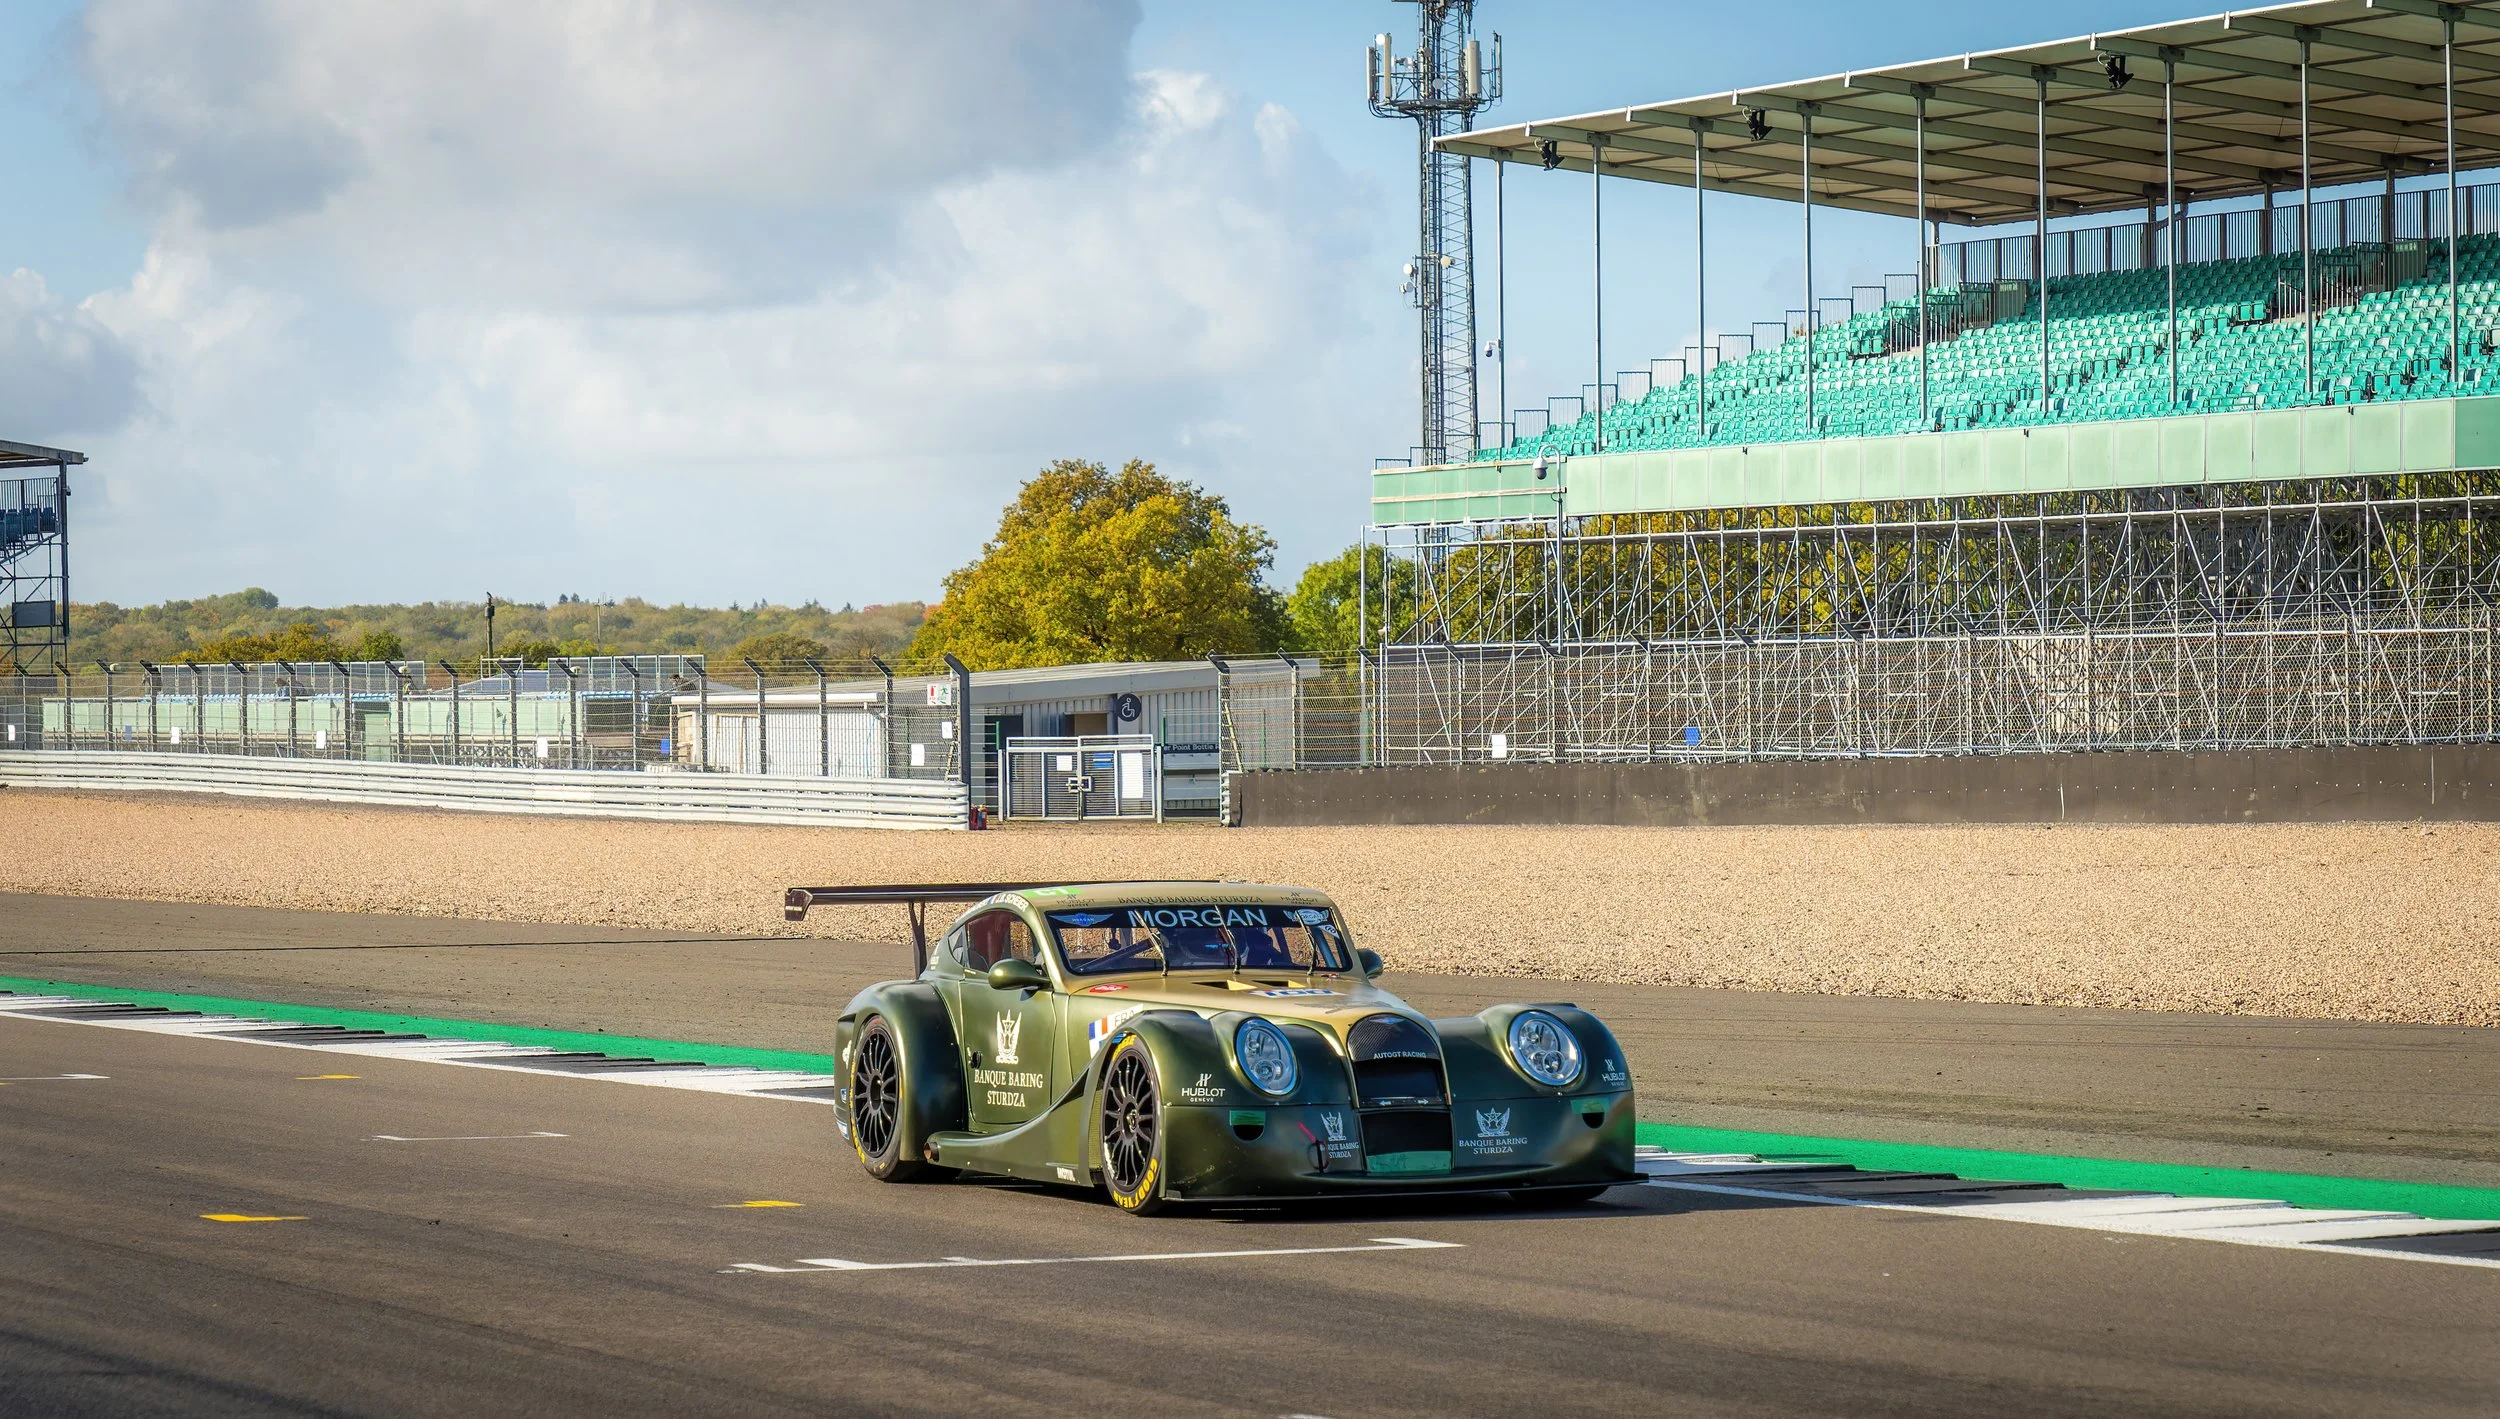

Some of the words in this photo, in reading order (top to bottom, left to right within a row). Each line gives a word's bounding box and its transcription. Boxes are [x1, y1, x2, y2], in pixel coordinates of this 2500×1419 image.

[1118, 896, 1166, 905] BANQUE
[1166, 896, 1209, 904] BARING
[1127, 908, 1268, 927] MORGAN
[1373, 1051, 1401, 1060] AUTOGT
[1402, 1051, 1427, 1059] RACING
[974, 1069, 1007, 1088] BANQUE
[1008, 1071, 1044, 1088] BARING
[1181, 1087, 1226, 1097] HUBLOT
[987, 1090, 1026, 1107] STURDZA
[1340, 1142, 1360, 1150] BARING
[1459, 1139, 1495, 1147] BANQUE
[1496, 1137, 1528, 1146] BARING
[1328, 1150, 1352, 1159] STURDZA
[1473, 1146, 1514, 1155] STURDZA
